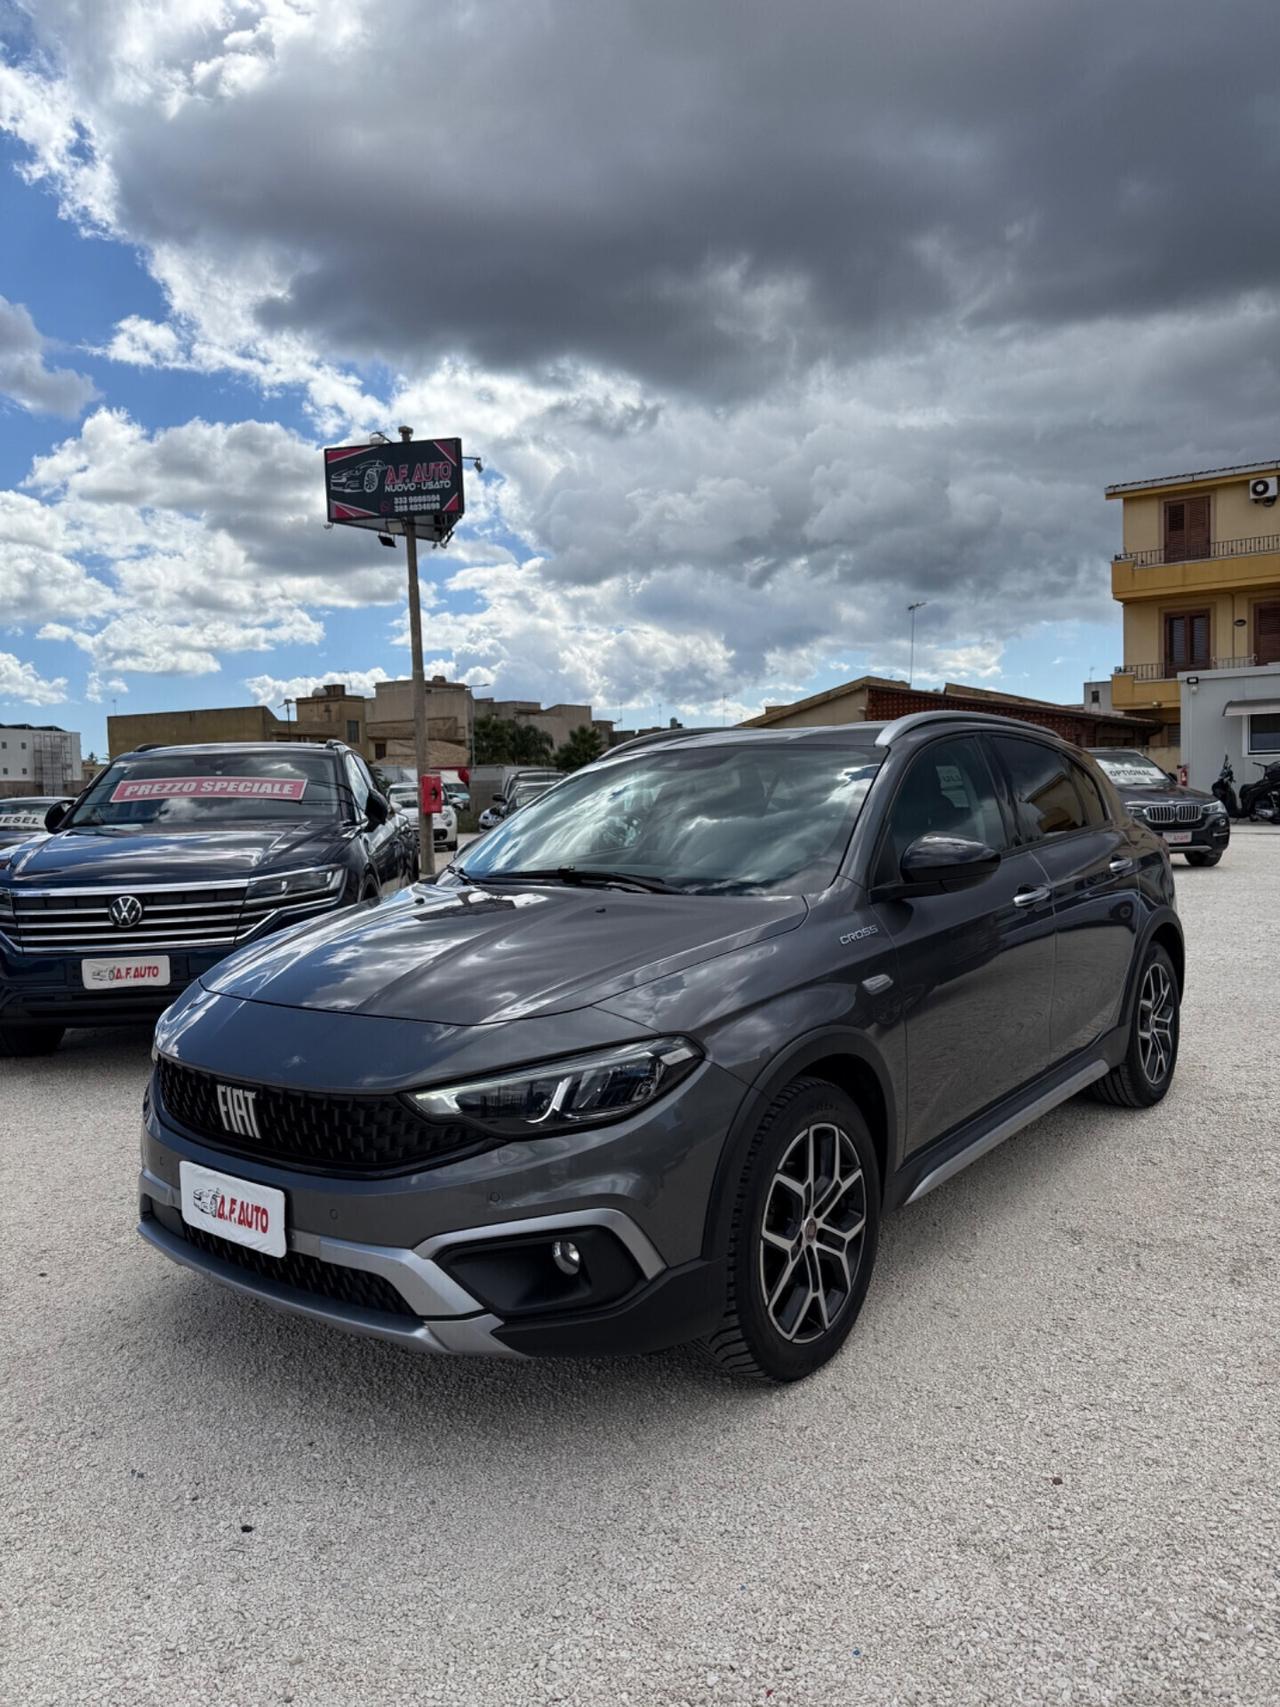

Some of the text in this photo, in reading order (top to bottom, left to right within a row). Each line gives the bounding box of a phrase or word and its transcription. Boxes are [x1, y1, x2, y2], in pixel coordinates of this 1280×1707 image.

[412, 461, 452, 482] AUTO
[384, 482, 416, 493] NUOVO
[421, 480, 451, 490] USATO
[1109, 768, 1154, 777] OPTIONAL
[124, 780, 295, 797] PREZZO SPECIALE
[839, 924, 879, 945] CROSS
[216, 1084, 262, 1139] FIAT
